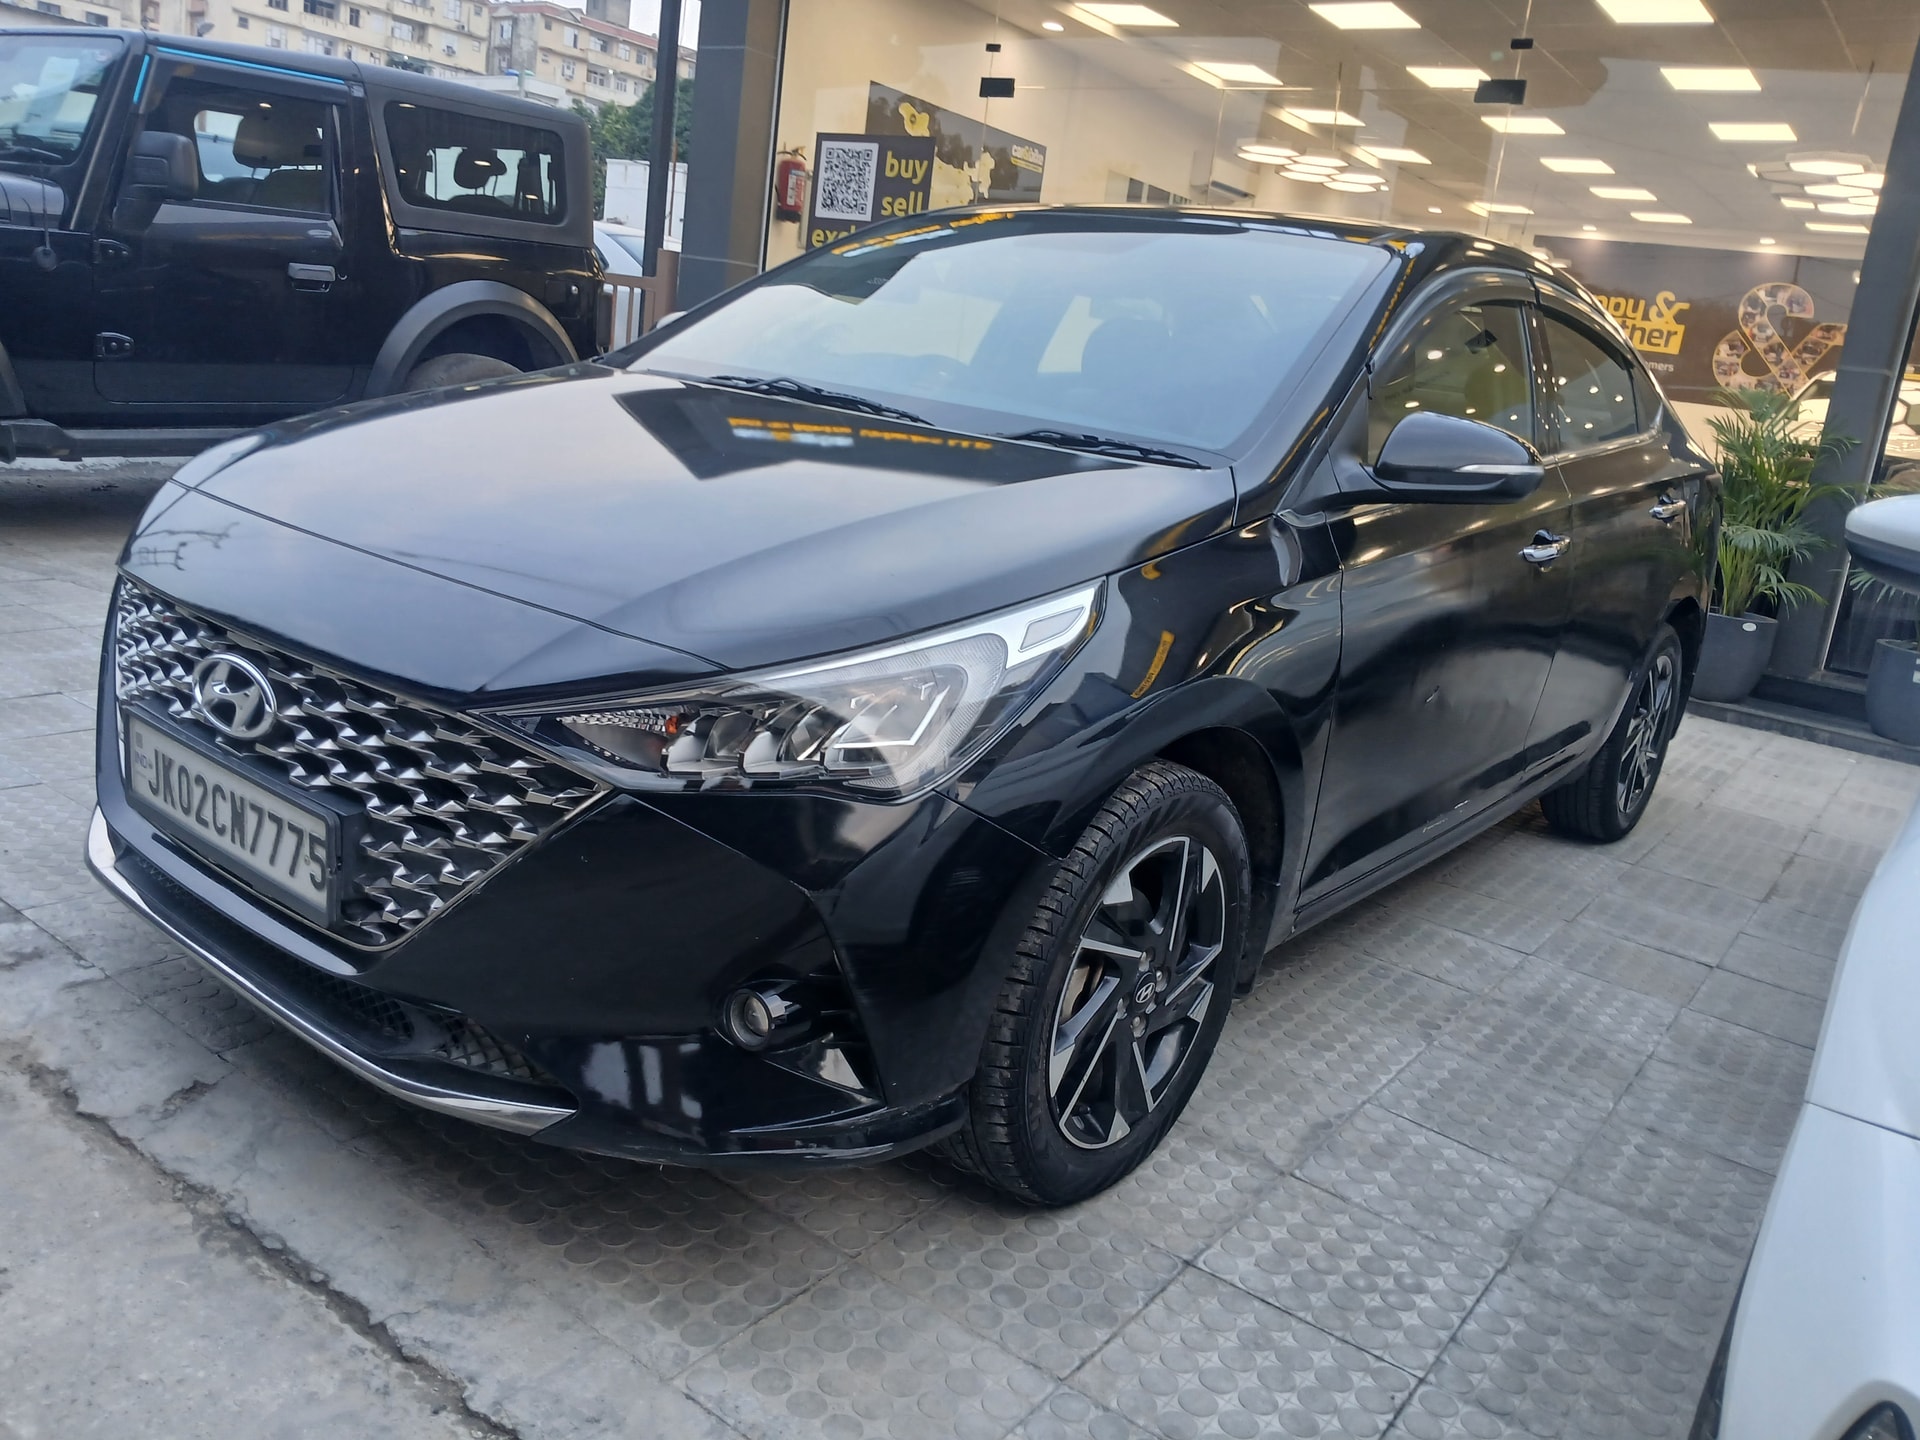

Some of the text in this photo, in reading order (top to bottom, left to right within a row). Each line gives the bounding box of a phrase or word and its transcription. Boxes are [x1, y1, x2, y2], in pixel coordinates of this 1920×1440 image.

[885, 150, 929, 185] buy
[880, 191, 924, 217] sell
[148, 748, 327, 891] JK02CN7775
